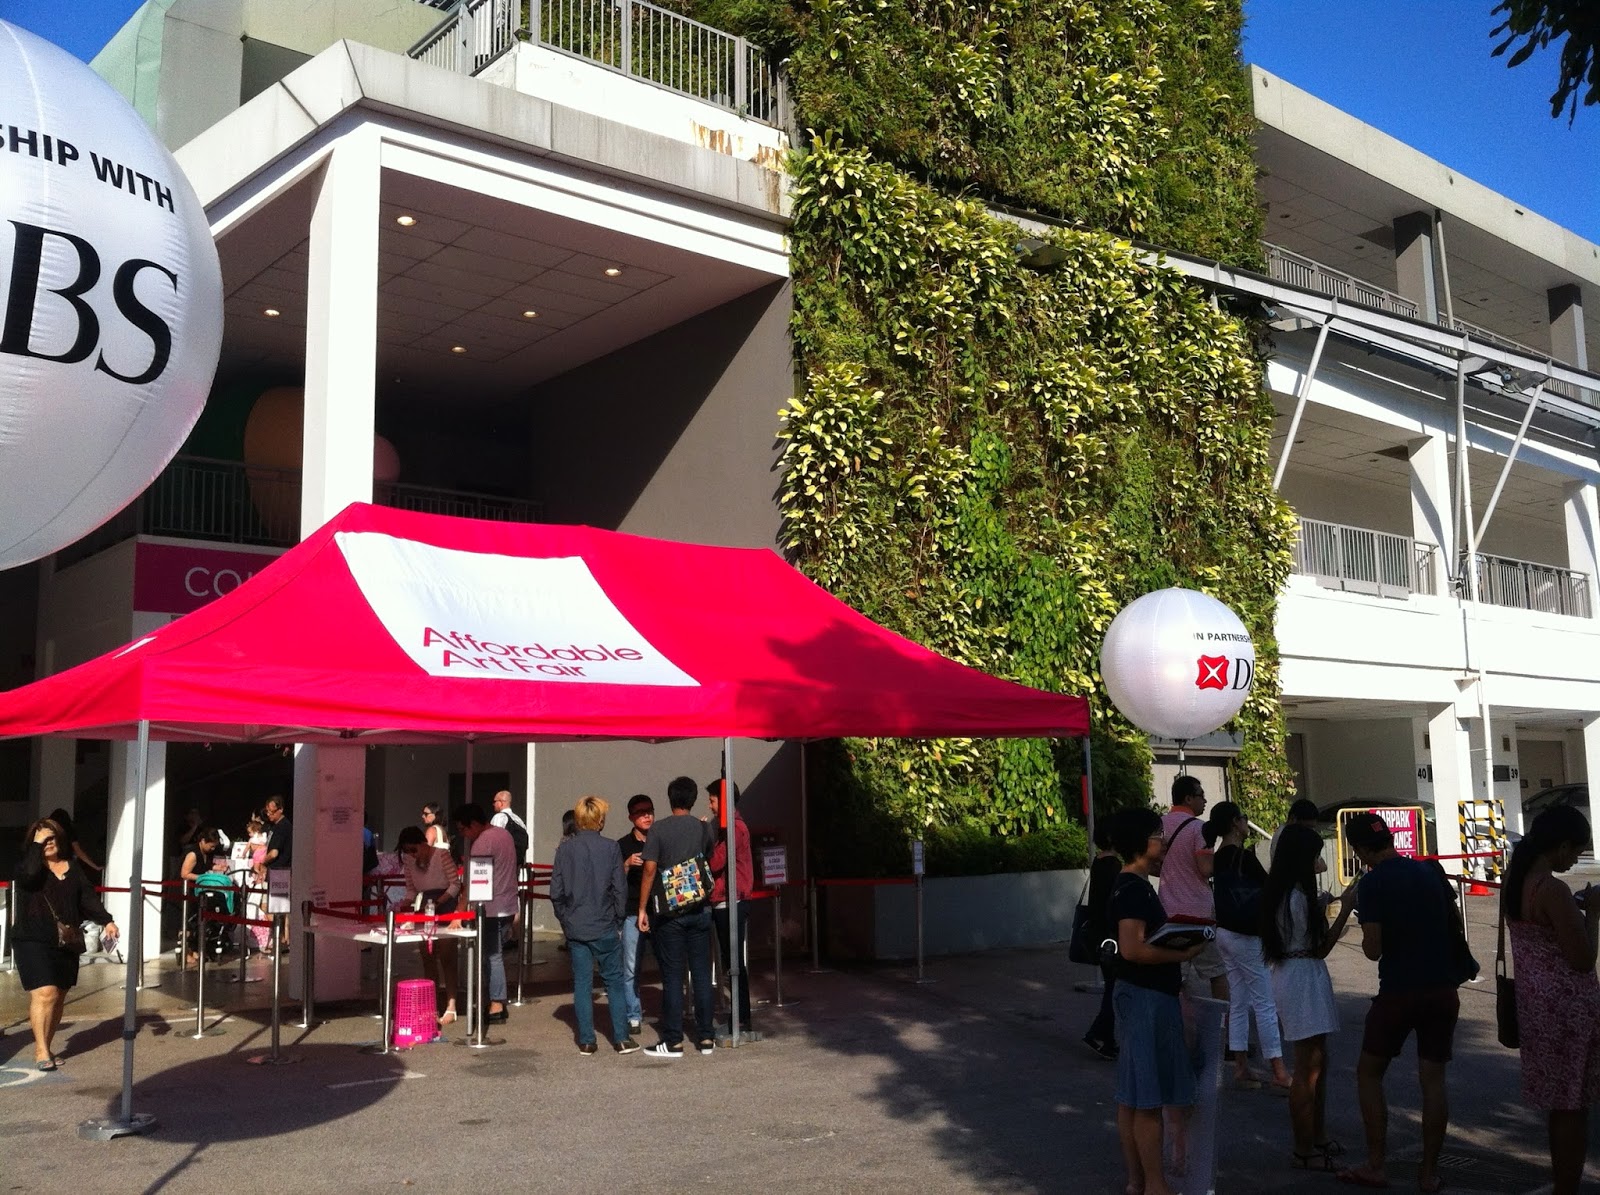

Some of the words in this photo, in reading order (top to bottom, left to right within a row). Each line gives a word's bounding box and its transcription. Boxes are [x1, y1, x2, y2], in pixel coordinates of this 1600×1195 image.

[0, 124, 79, 167] HIP
[89, 151, 175, 214] WITH
[185, 566, 253, 597] CO
[423, 627, 643, 661] Affordable
[443, 650, 513, 672] Art
[508, 658, 587, 677] Fair
[1231, 658, 1254, 691] D
[1418, 768, 1426, 779] 40
[1511, 768, 1518, 779] 39
[271, 881, 289, 889] PRESS
